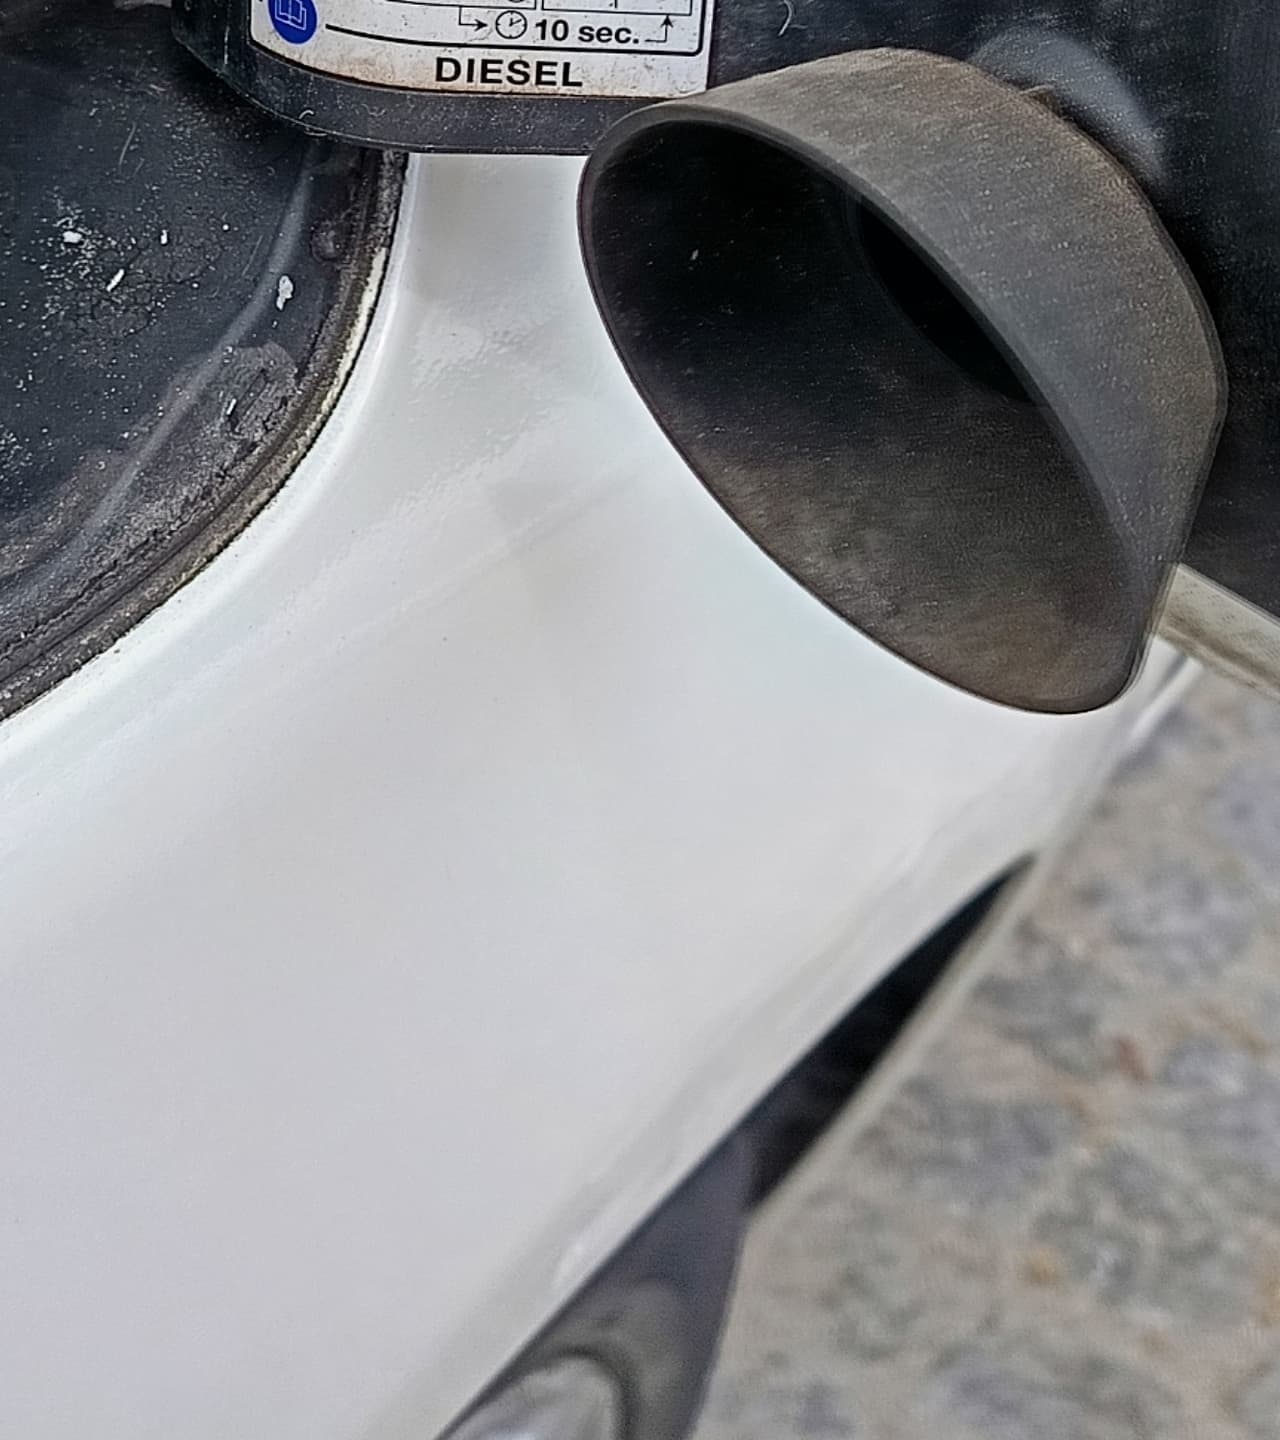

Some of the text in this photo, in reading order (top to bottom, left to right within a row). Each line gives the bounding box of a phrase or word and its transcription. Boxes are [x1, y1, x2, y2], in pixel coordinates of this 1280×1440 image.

[535, 19, 639, 45] 10 sec.
[435, 56, 583, 87] DIESEL
